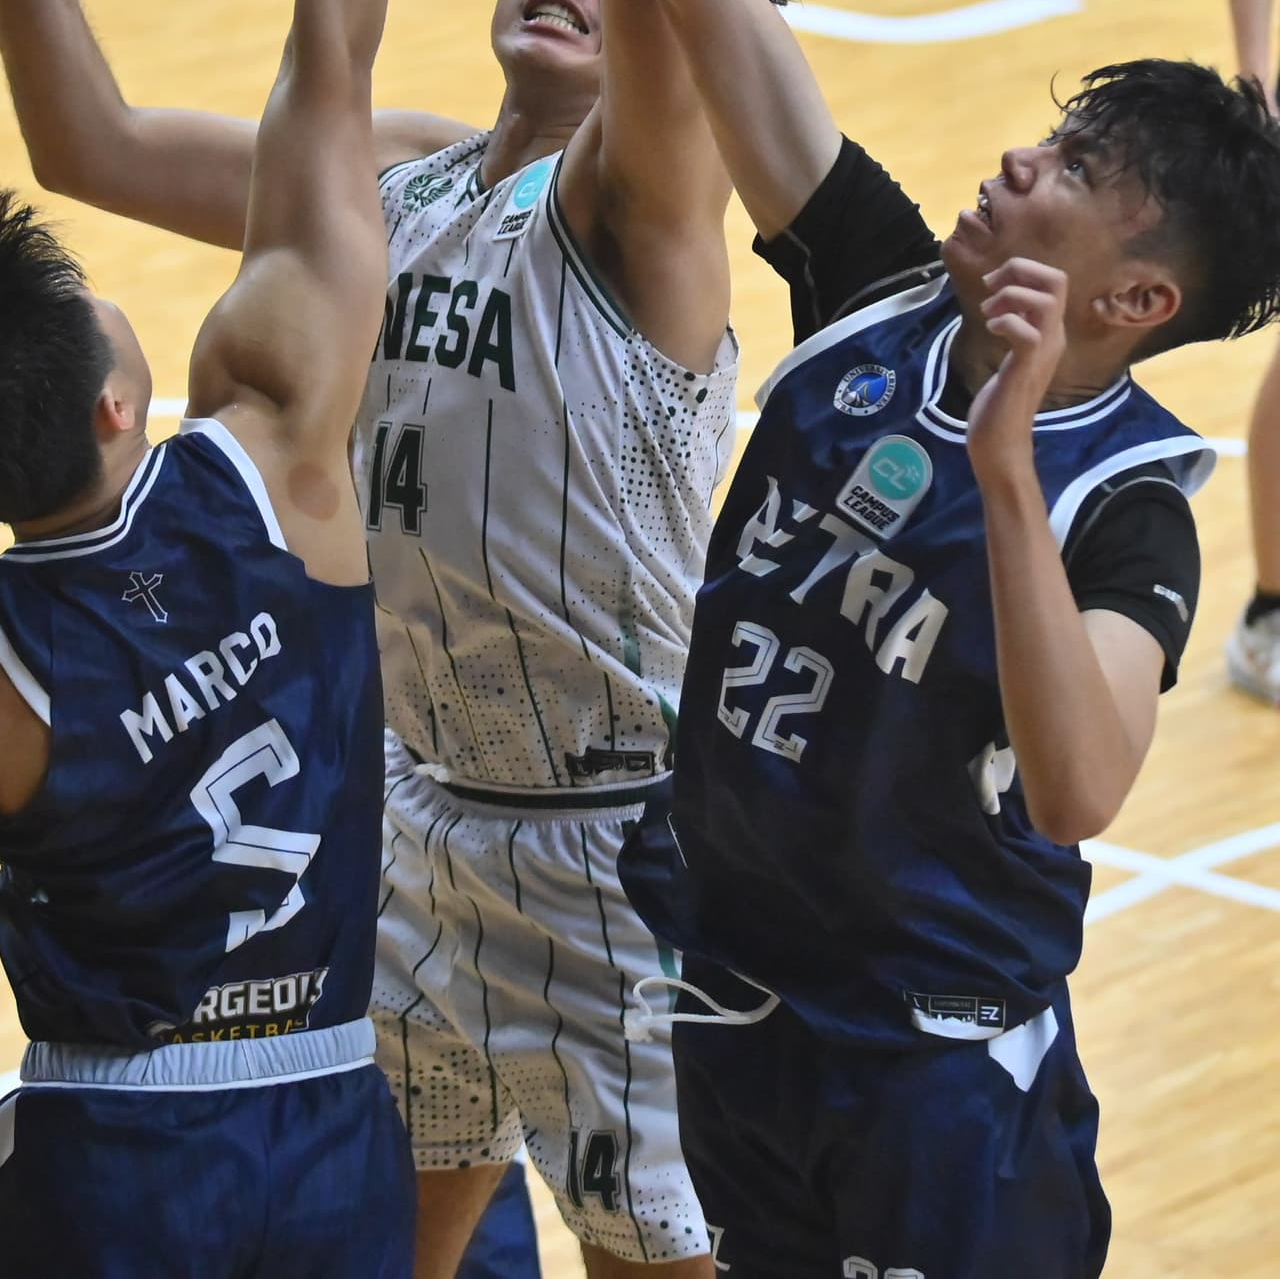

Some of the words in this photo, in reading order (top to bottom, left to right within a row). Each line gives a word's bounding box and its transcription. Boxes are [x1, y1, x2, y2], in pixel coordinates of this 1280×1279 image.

[373, 272, 517, 393] NESA
[366, 421, 428, 537] 14
[843, 495, 891, 531] LEAGUE
[850, 485, 901, 524] CAMPUS
[120, 611, 282, 765] MARCO
[717, 621, 835, 763] 22
[190, 718, 321, 953] 5
[566, 1127, 621, 1213] 14
